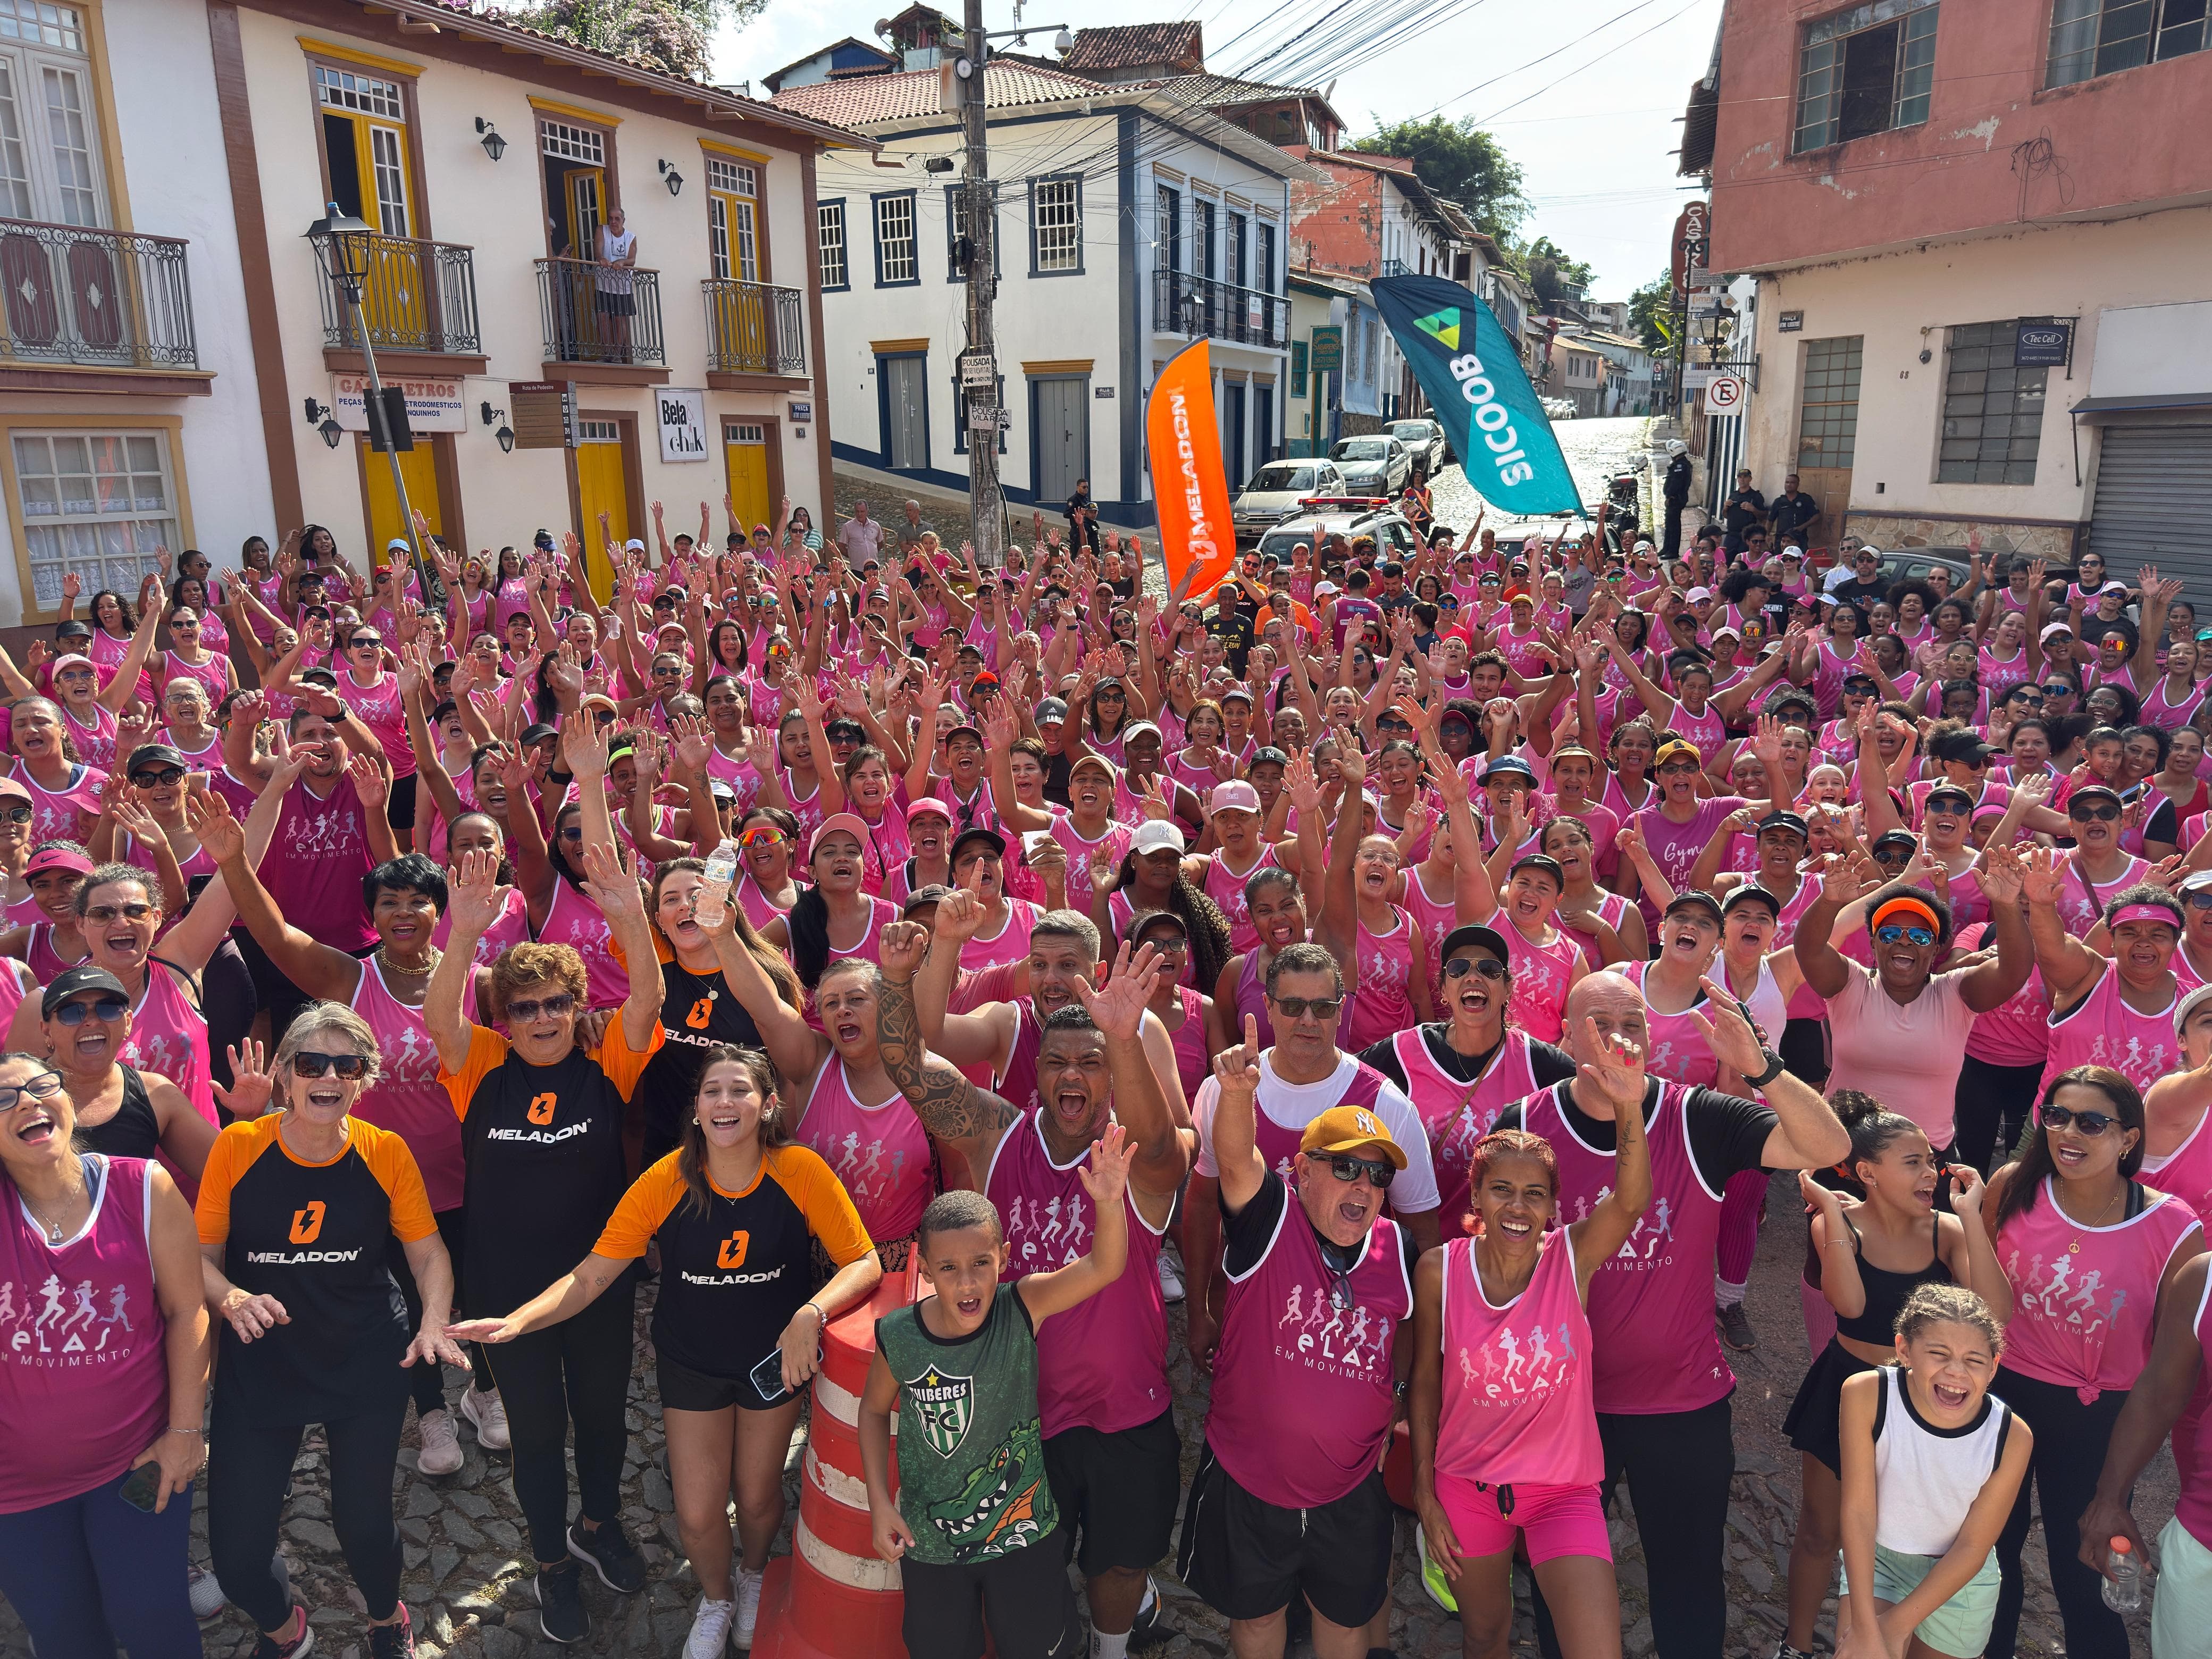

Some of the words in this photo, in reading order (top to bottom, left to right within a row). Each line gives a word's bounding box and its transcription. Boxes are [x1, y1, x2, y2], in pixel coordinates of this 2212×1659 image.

[2030, 334, 2041, 343] Tec
[2042, 334, 2056, 343] Cell
[963, 358, 990, 366] POUSADA
[1899, 370, 1909, 379] 68
[386, 382, 456, 398] ETROS
[661, 400, 688, 425] Bela
[972, 407, 1008, 416] POUSADA
[1450, 354, 1534, 486] SICOOB
[1170, 395, 1208, 536] MELADON
[296, 836, 349, 853] eLAS
[1664, 842, 1704, 867] Gym
[582, 943, 607, 955] eL
[488, 1122, 587, 1144] MELADON
[248, 1250, 359, 1264] MELADON
[1022, 1242, 1080, 1264] eLA
[1596, 1256, 1672, 1271] VIMENTO
[682, 1269, 781, 1286] MELADON
[2022, 1293, 2102, 1334] eLAS
[11, 1328, 111, 1353] eLAS
[20, 1348, 131, 1368] MOVIMENTO
[1276, 1345, 1294, 1361] EM
[1297, 1333, 1376, 1370] eLAS
[1485, 1362, 1566, 1398] eLAS
[1472, 1397, 1489, 1408] EM
[921, 1407, 961, 1433] FC
